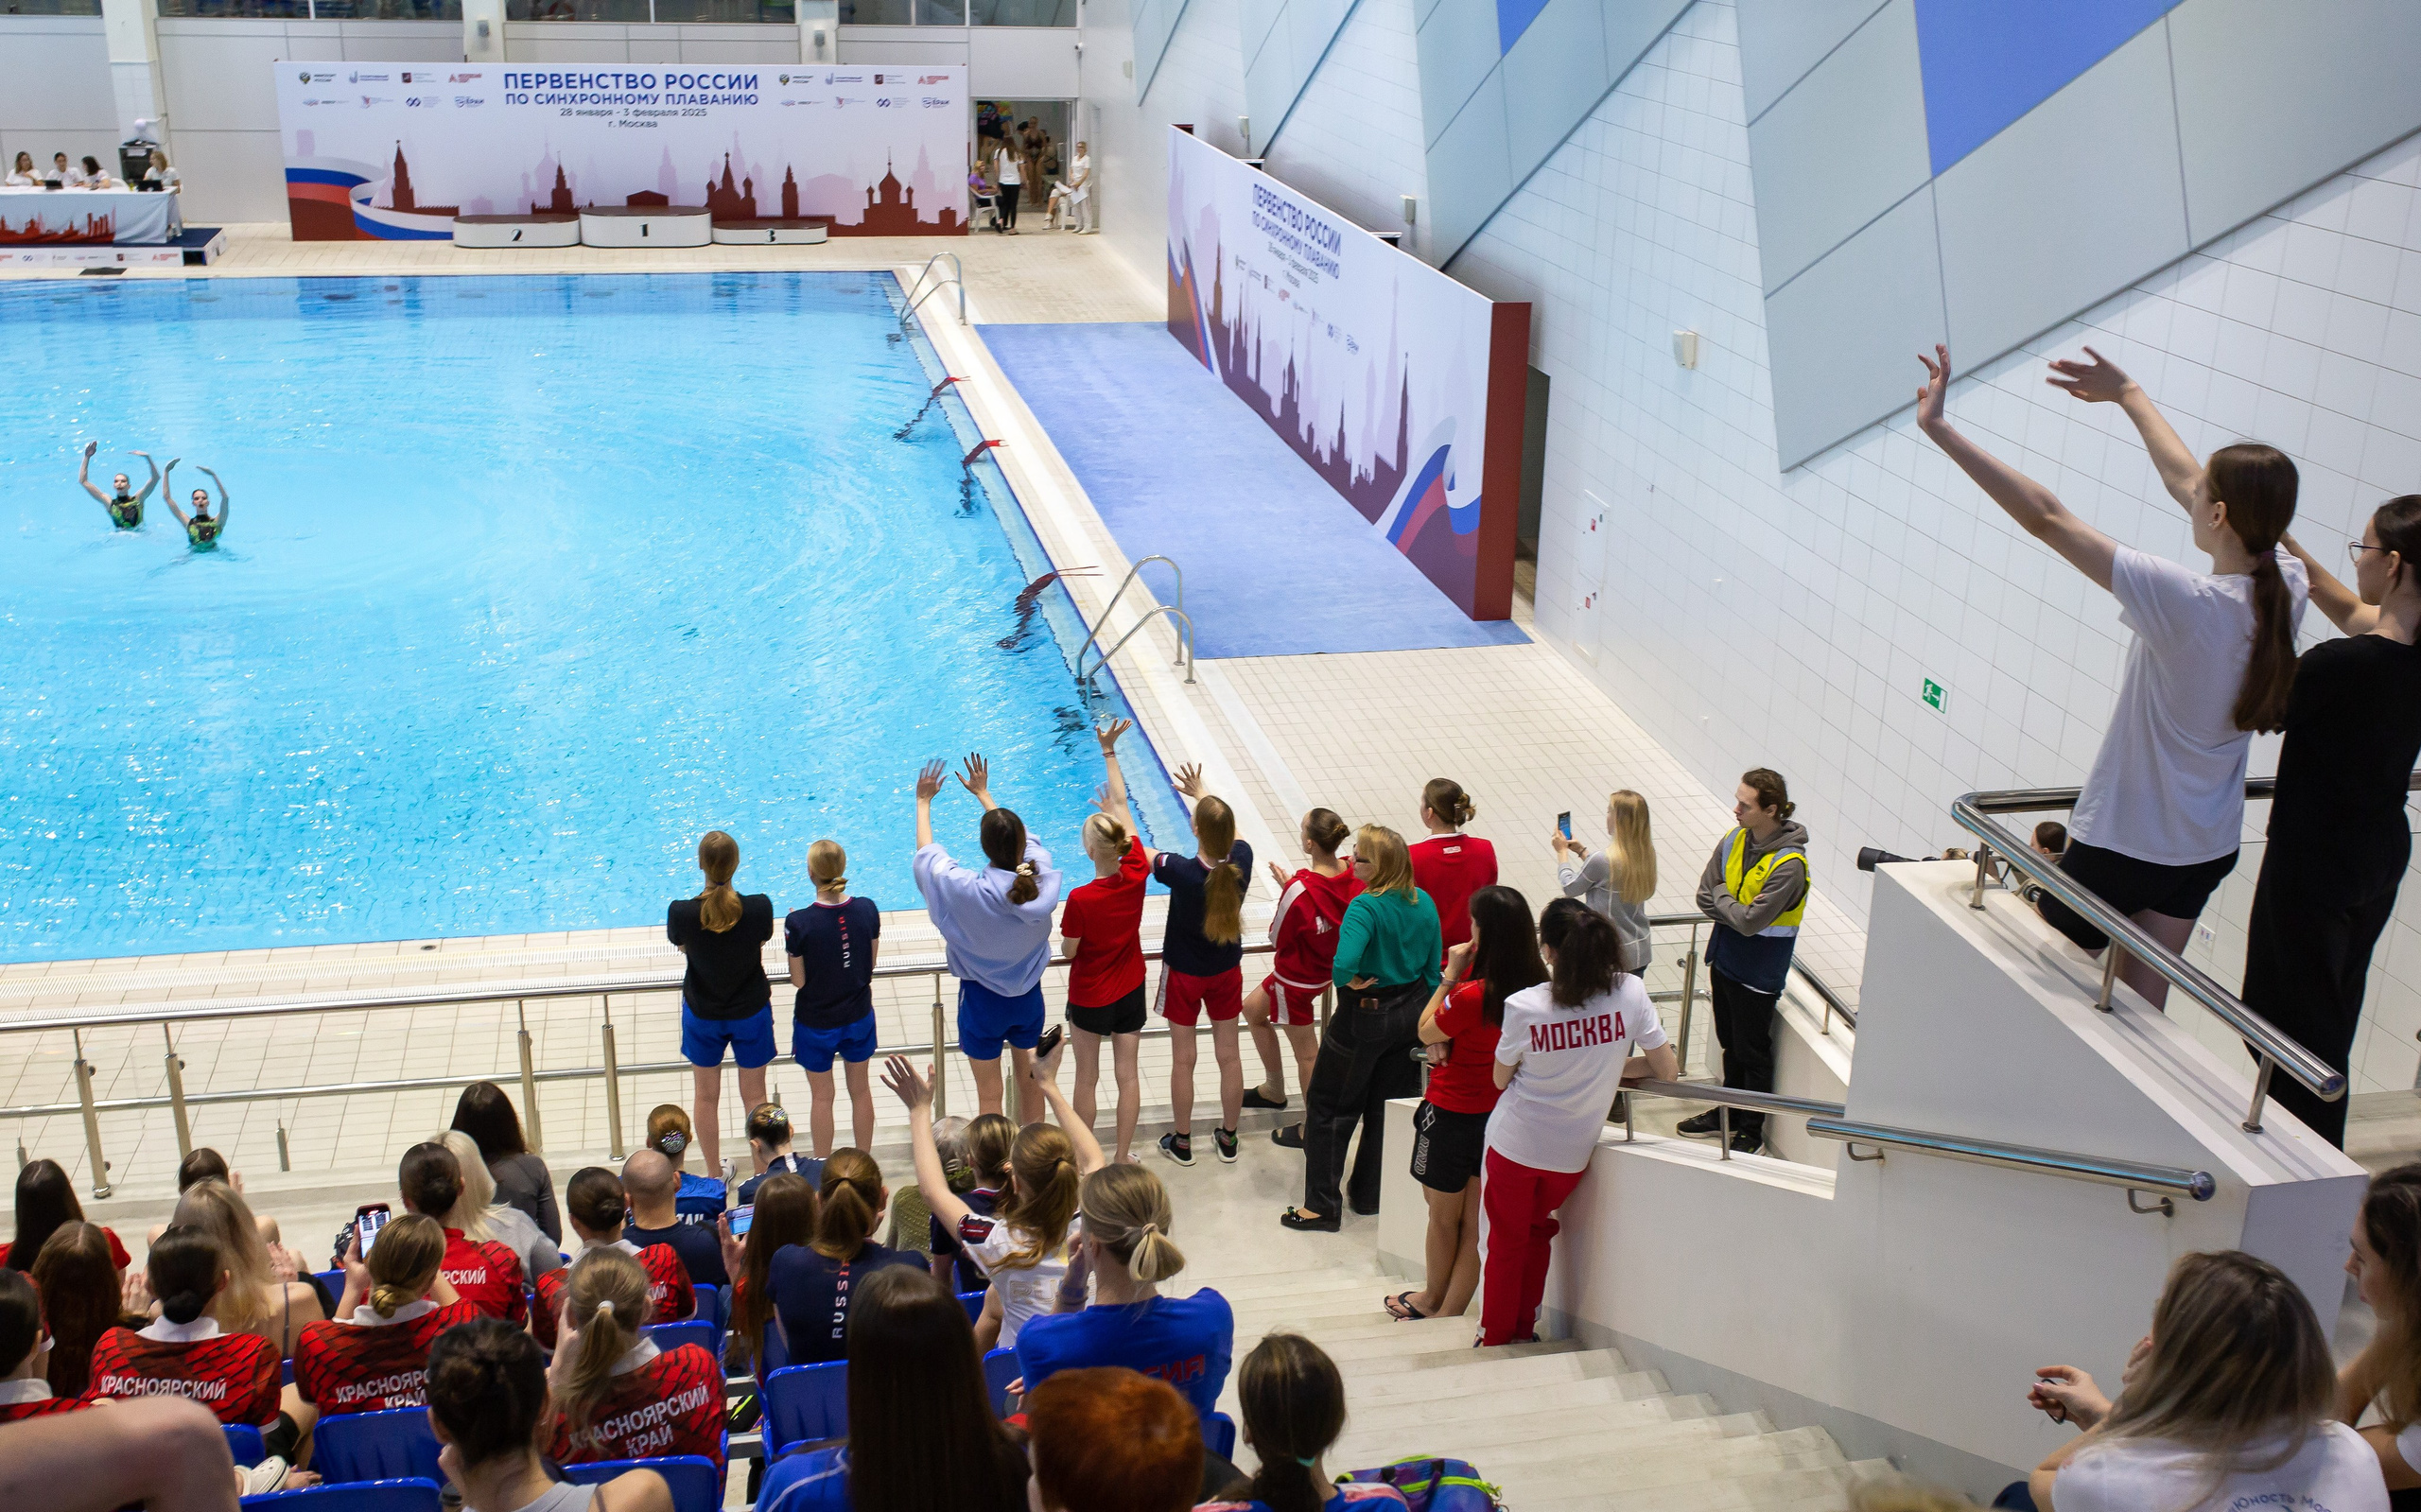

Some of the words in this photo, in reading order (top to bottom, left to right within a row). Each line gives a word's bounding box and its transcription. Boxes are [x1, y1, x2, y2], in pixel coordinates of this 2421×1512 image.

[504, 73, 656, 90] ПЕРВЕНСТВО
[665, 74, 758, 90] РОССИИ
[505, 93, 530, 105] ПО
[534, 93, 660, 105] СИНХРОННОМУ
[665, 94, 758, 105] ПЛАВАНИЮ
[560, 108, 573, 116] 28
[575, 110, 614, 118] января
[623, 108, 631, 116] 3
[632, 108, 679, 118] февраля
[681, 108, 707, 116] 2025
[1253, 183, 1303, 233] ПЕРВЕНСТВО
[1305, 214, 1341, 257] РОССИИ
[511, 229, 523, 241] 2
[639, 223, 649, 236] 1
[765, 228, 776, 242] 3
[1529, 1011, 1626, 1052] МОСКВА
[100, 1375, 227, 1399] КРАСНОЯРСКИЙ
[625, 1419, 673, 1457] КРАЙ
